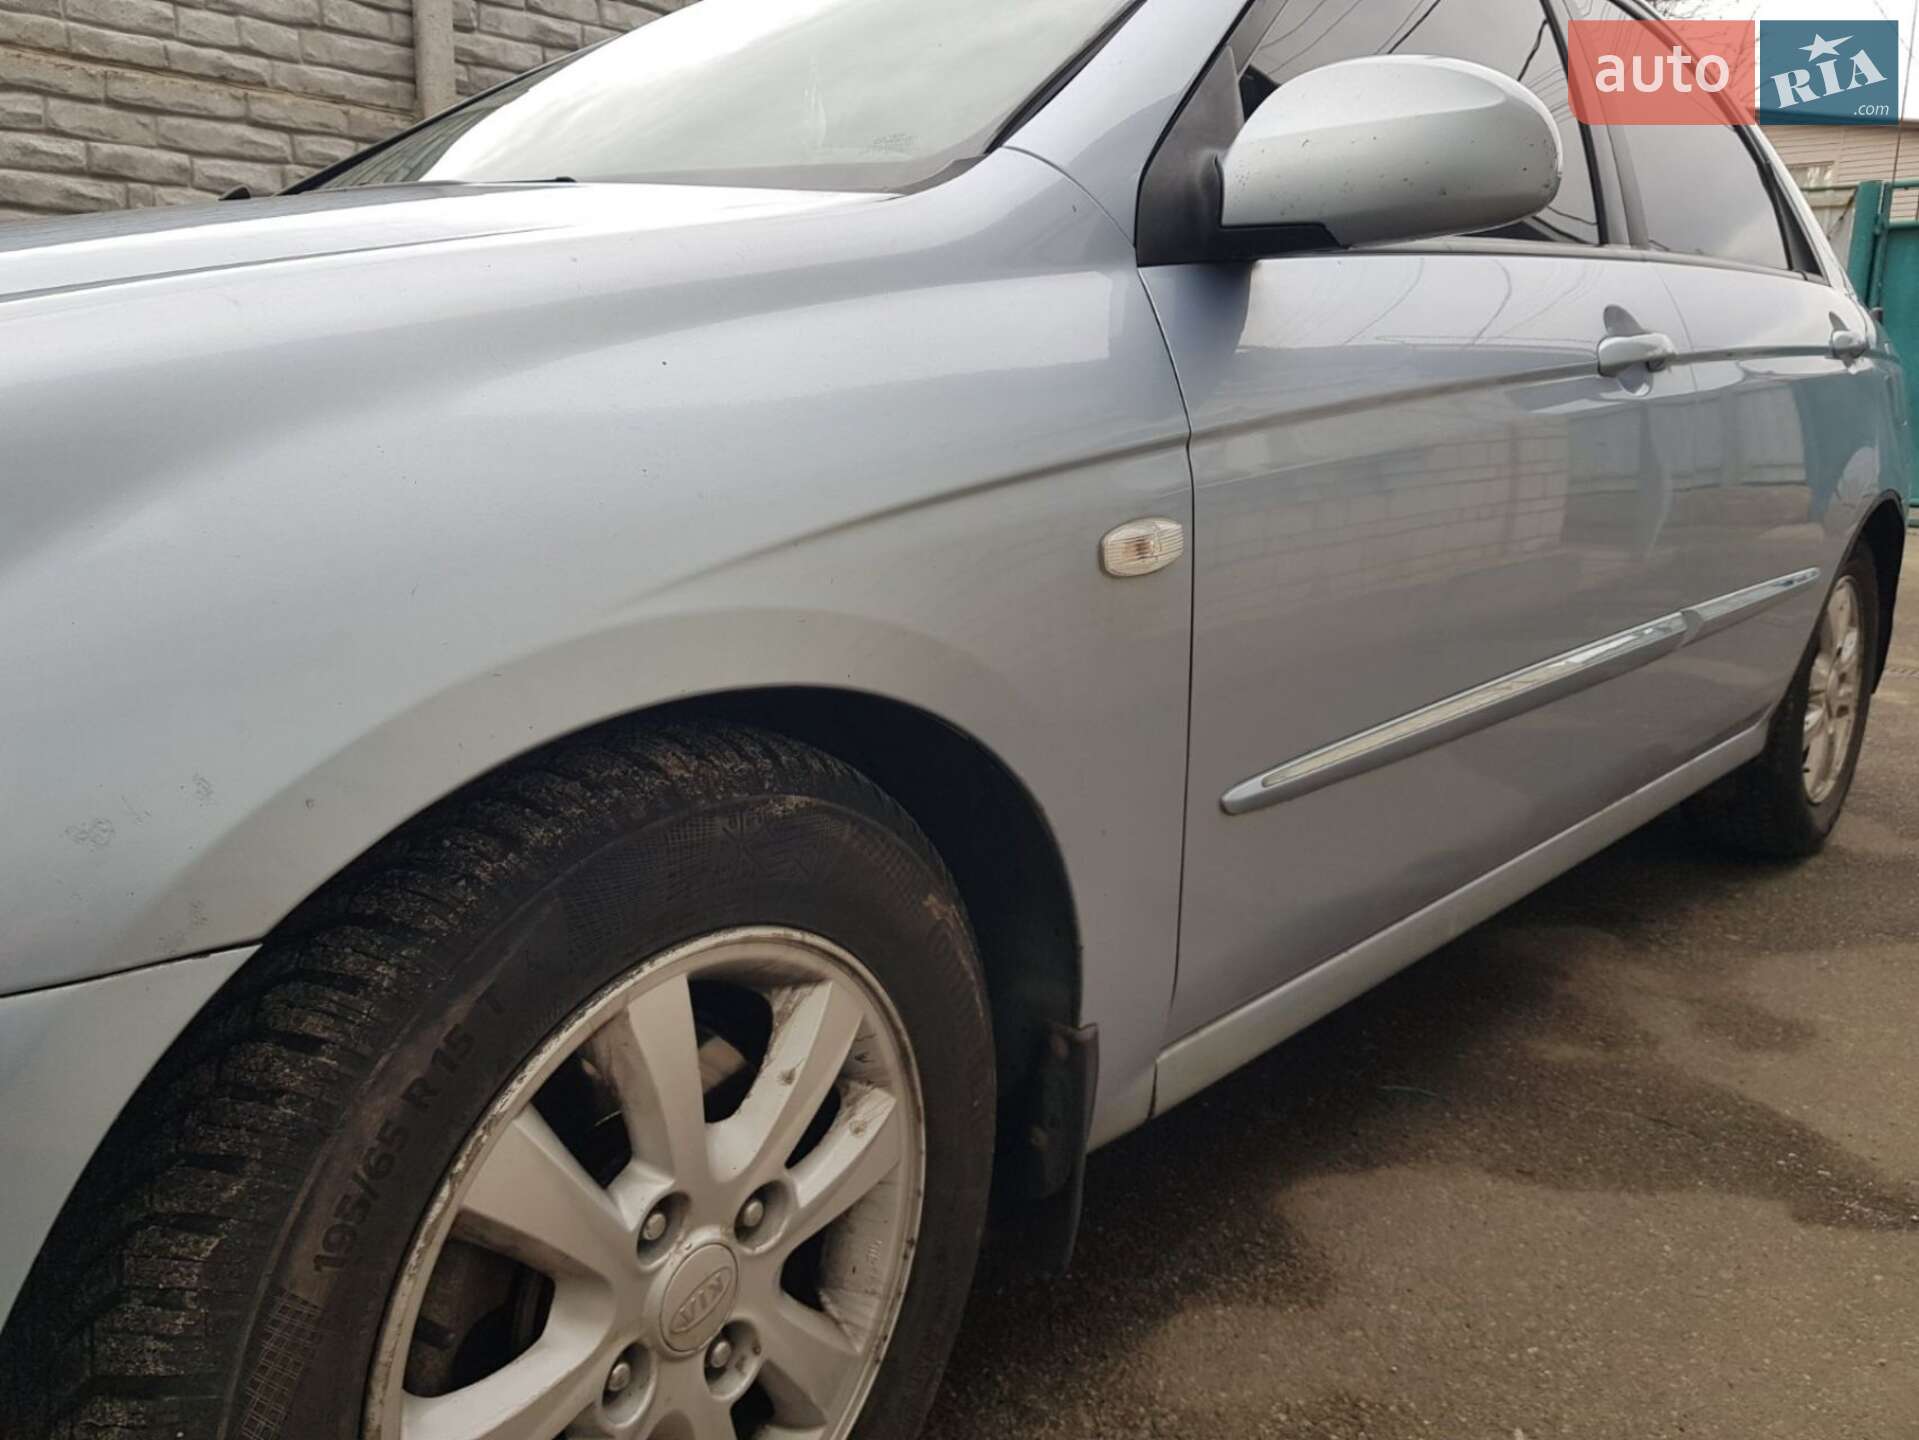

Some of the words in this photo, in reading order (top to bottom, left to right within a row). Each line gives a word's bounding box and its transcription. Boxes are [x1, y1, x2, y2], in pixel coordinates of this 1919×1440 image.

[313, 1119, 410, 1272] 195/65
[402, 1077, 442, 1113] R
[431, 1024, 476, 1075] 15
[675, 1272, 725, 1329] KIA
